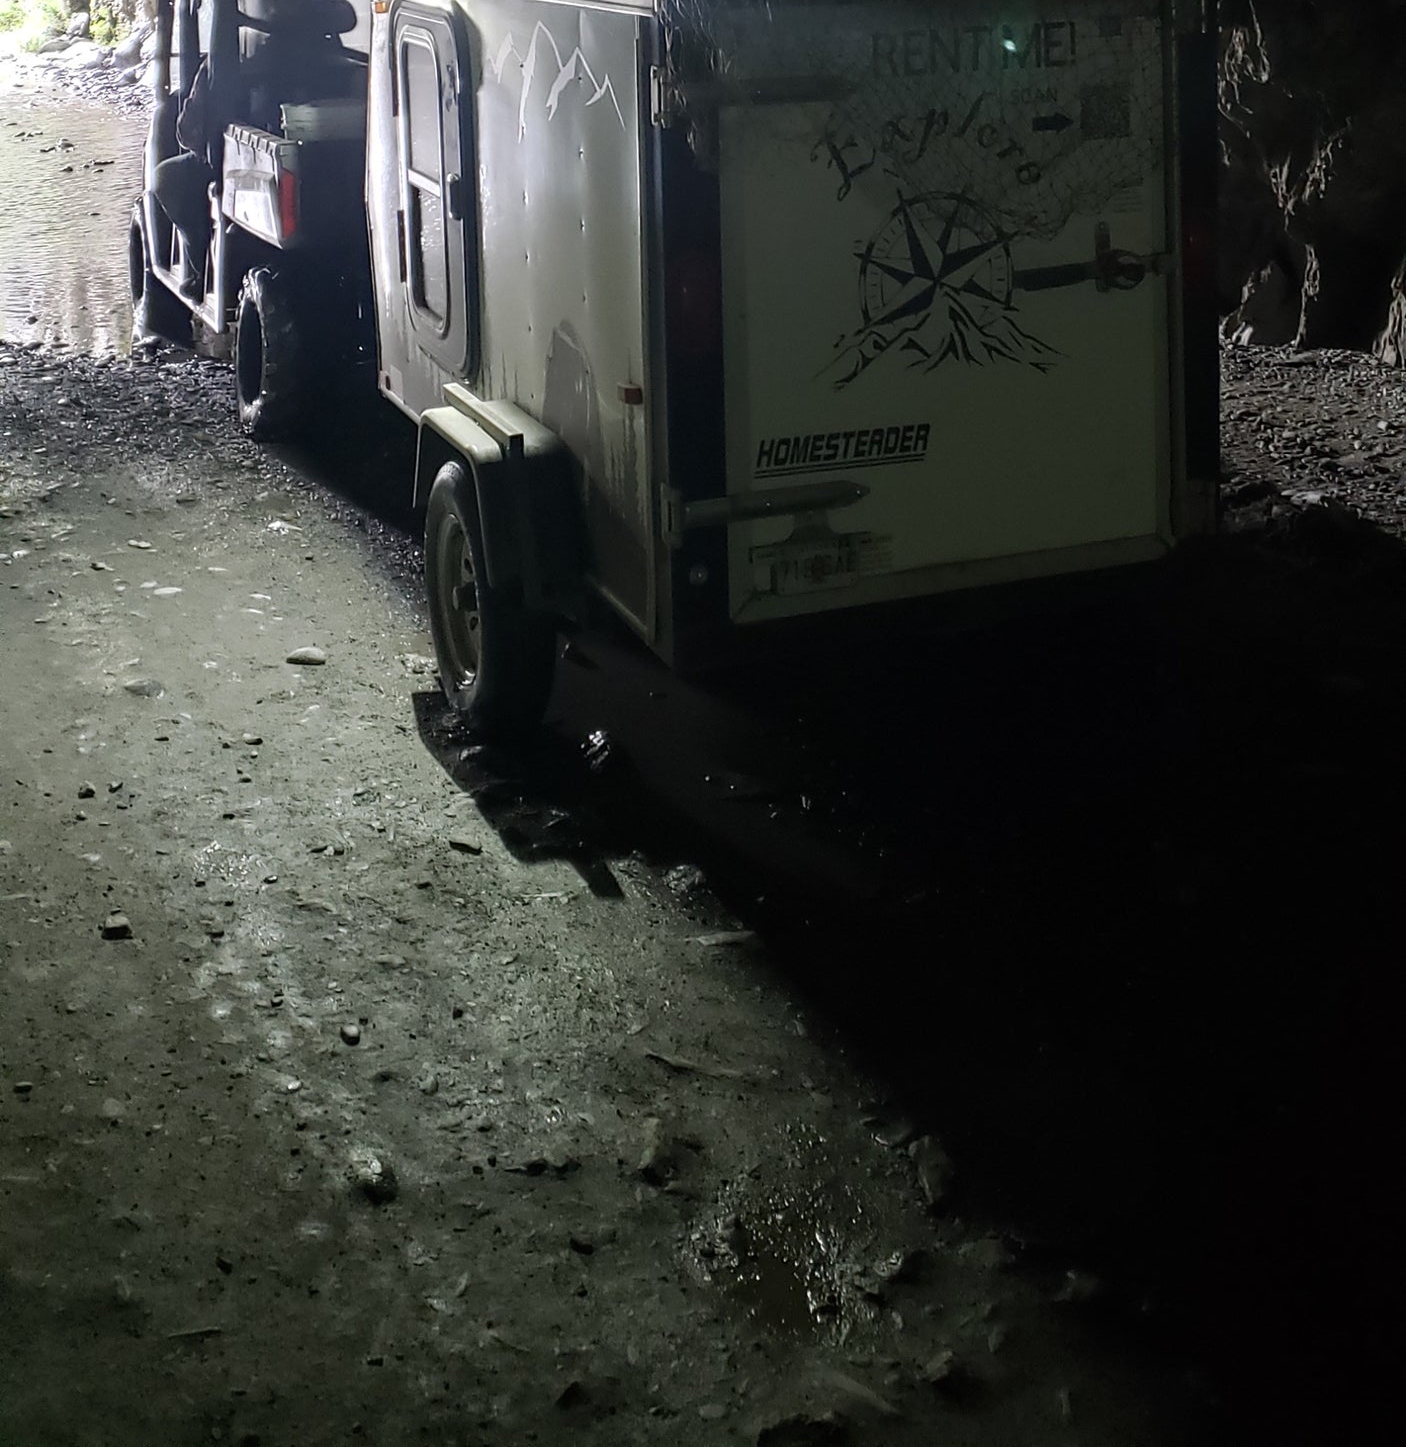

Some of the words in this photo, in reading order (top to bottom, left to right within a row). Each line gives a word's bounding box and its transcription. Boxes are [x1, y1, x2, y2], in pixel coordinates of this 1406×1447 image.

[871, 24, 993, 77] RENT
[1001, 20, 1076, 69] ME!
[1008, 86, 1059, 105] SCAN
[809, 90, 1042, 203] Explore
[755, 422, 931, 469] HOMESTEADER
